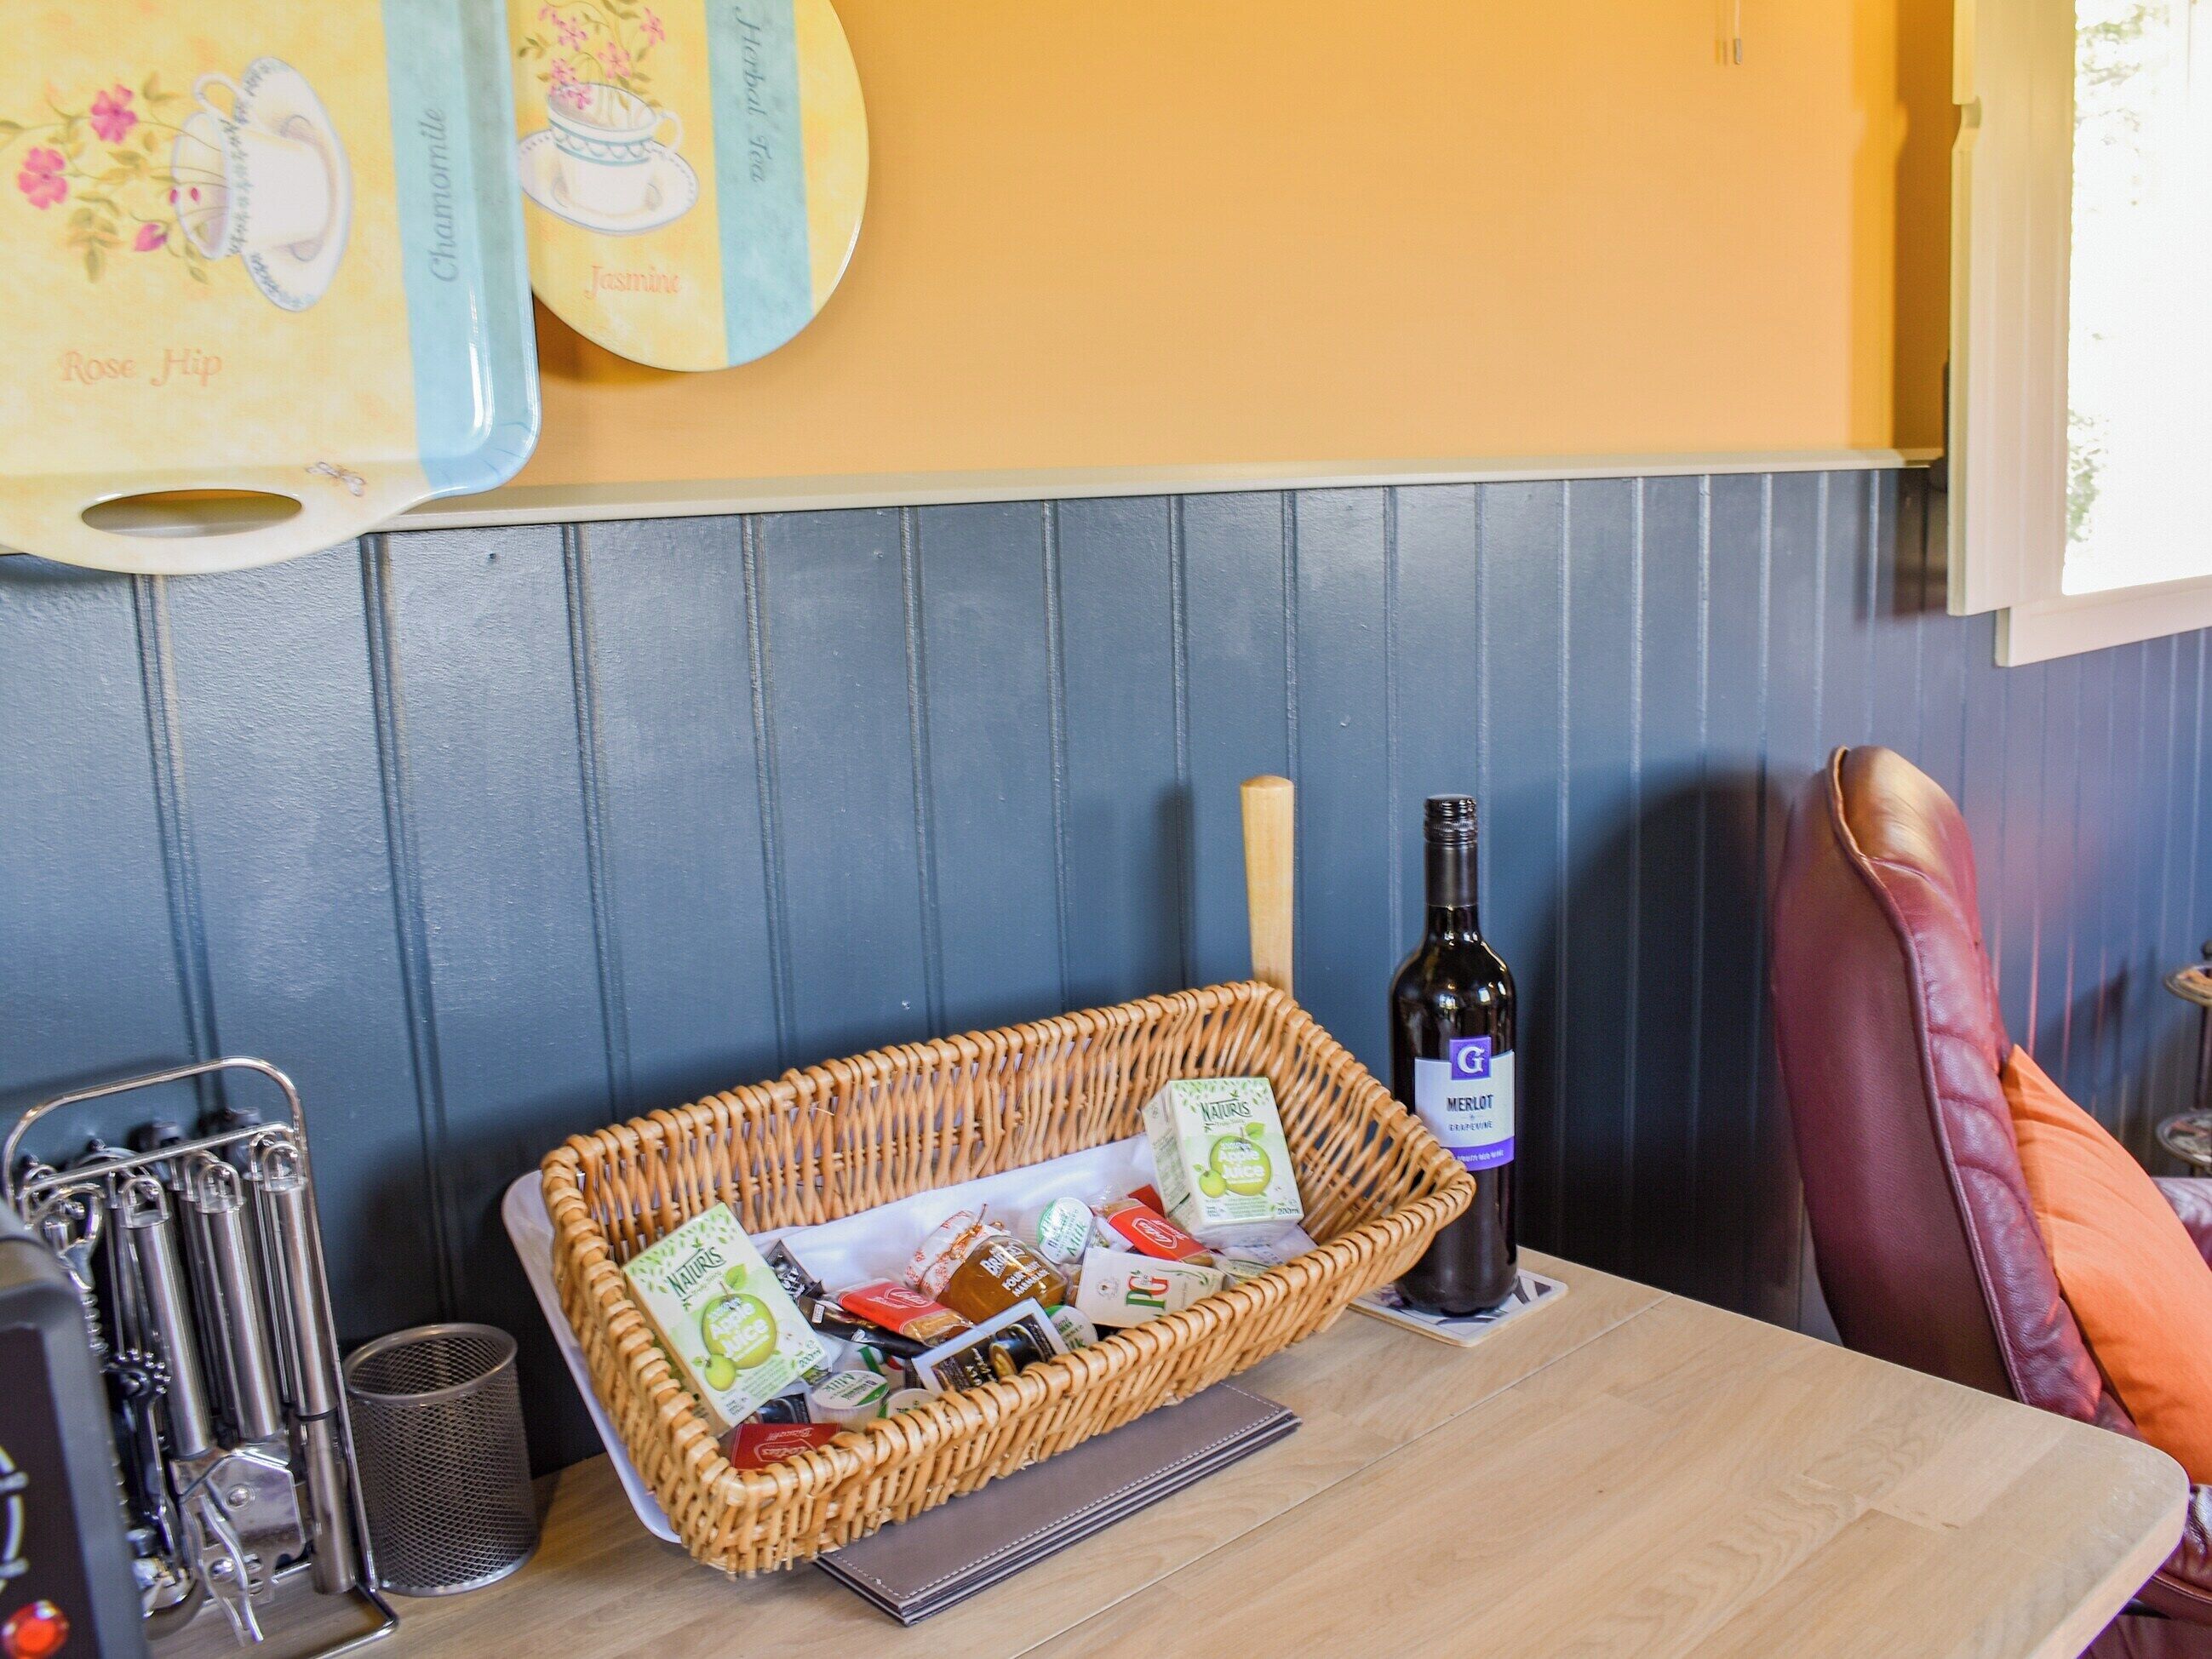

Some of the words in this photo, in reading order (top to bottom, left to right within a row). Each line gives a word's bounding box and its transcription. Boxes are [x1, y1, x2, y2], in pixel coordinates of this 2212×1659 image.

[736, 7, 767, 117] Herbal
[751, 134, 771, 183] Tea
[417, 107, 458, 283] Chamomile
[584, 265, 679, 300] Jasmine
[60, 350, 136, 386] Rose
[150, 348, 223, 386] Hip
[1457, 1046, 1485, 1073] G
[1447, 1094, 1494, 1112] MERLOT
[1449, 1120, 1493, 1132] GRAPEVINE
[1125, 1275, 1172, 1311] PG
